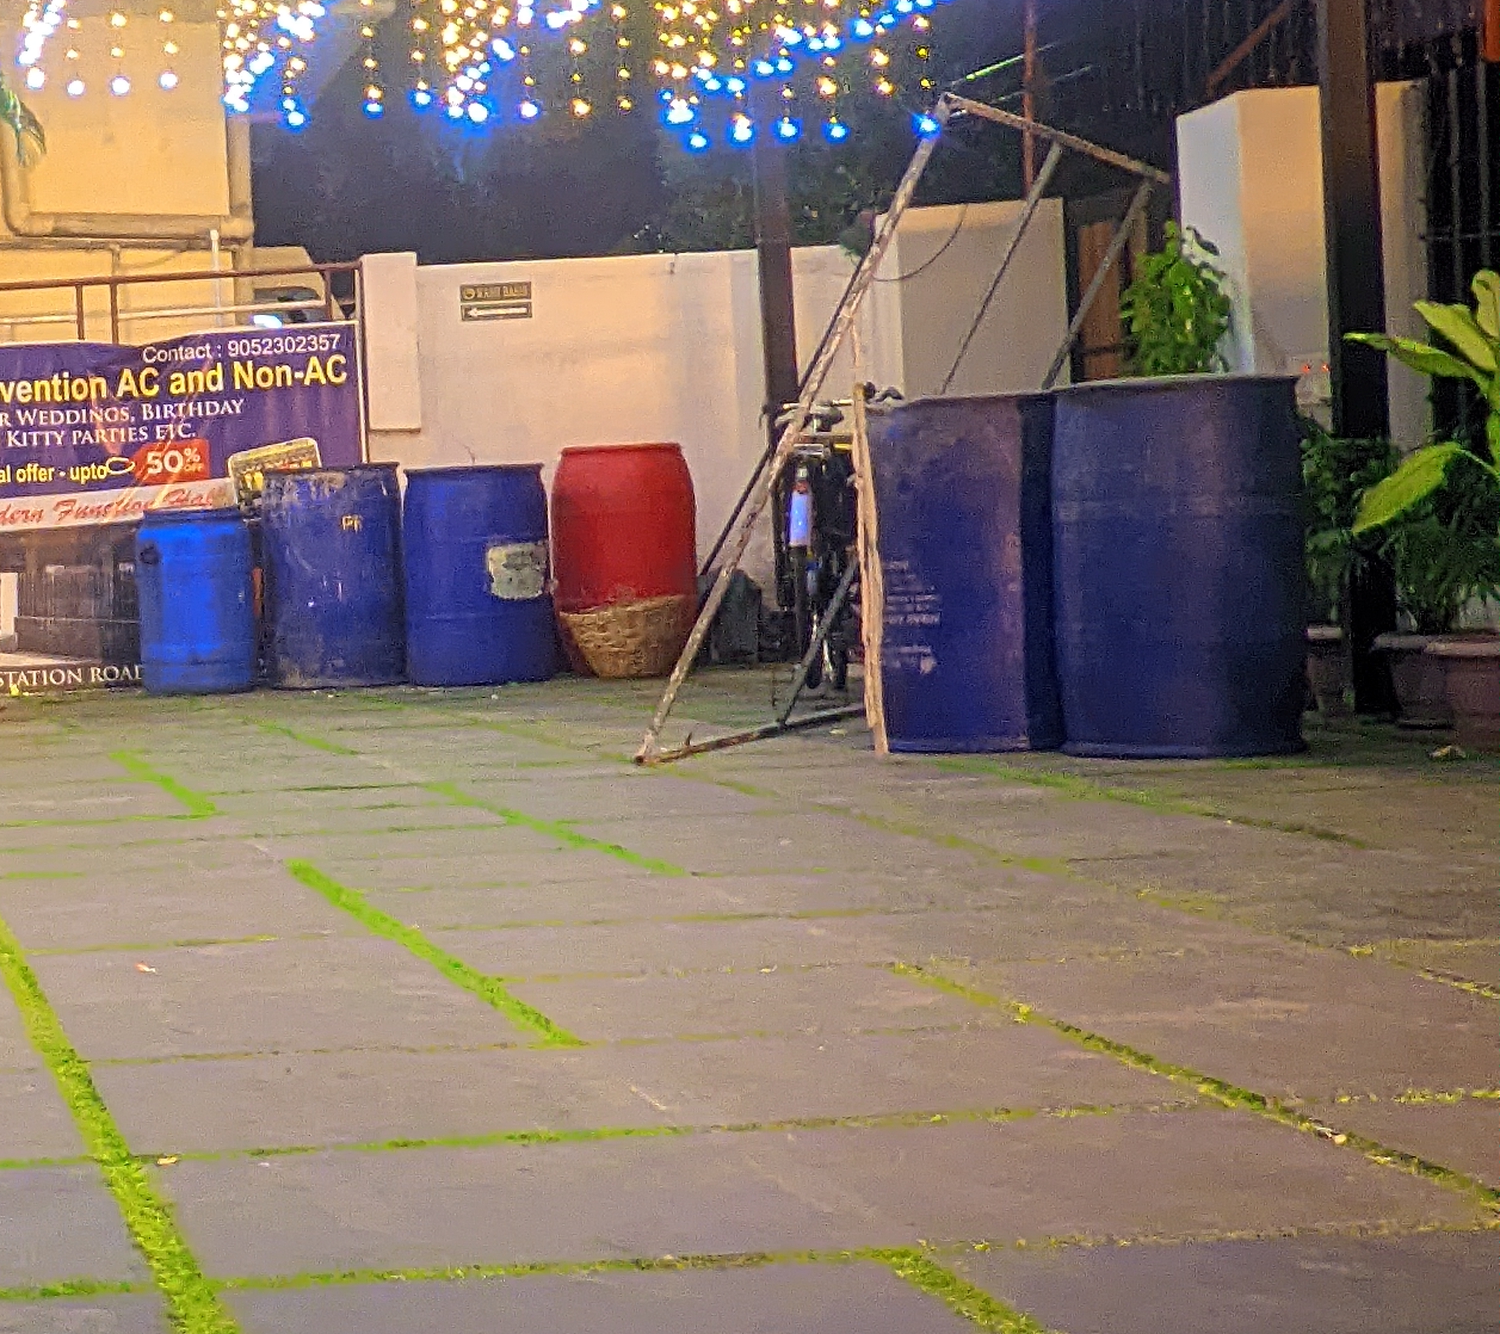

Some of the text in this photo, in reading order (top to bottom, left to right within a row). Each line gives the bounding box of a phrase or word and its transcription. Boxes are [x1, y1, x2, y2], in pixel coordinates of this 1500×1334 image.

[143, 342, 212, 364] Contact
[227, 334, 341, 357] 9052302357
[116, 367, 159, 399] AC
[169, 362, 224, 395] and
[233, 354, 348, 390] Non-AC
[16, 404, 135, 427] WEDDINGS,
[142, 399, 244, 421] BIRTHDAY
[6, 430, 65, 448] KITTY
[72, 426, 150, 446] PARTIES
[16, 462, 55, 483] offer
[70, 464, 109, 486] upto
